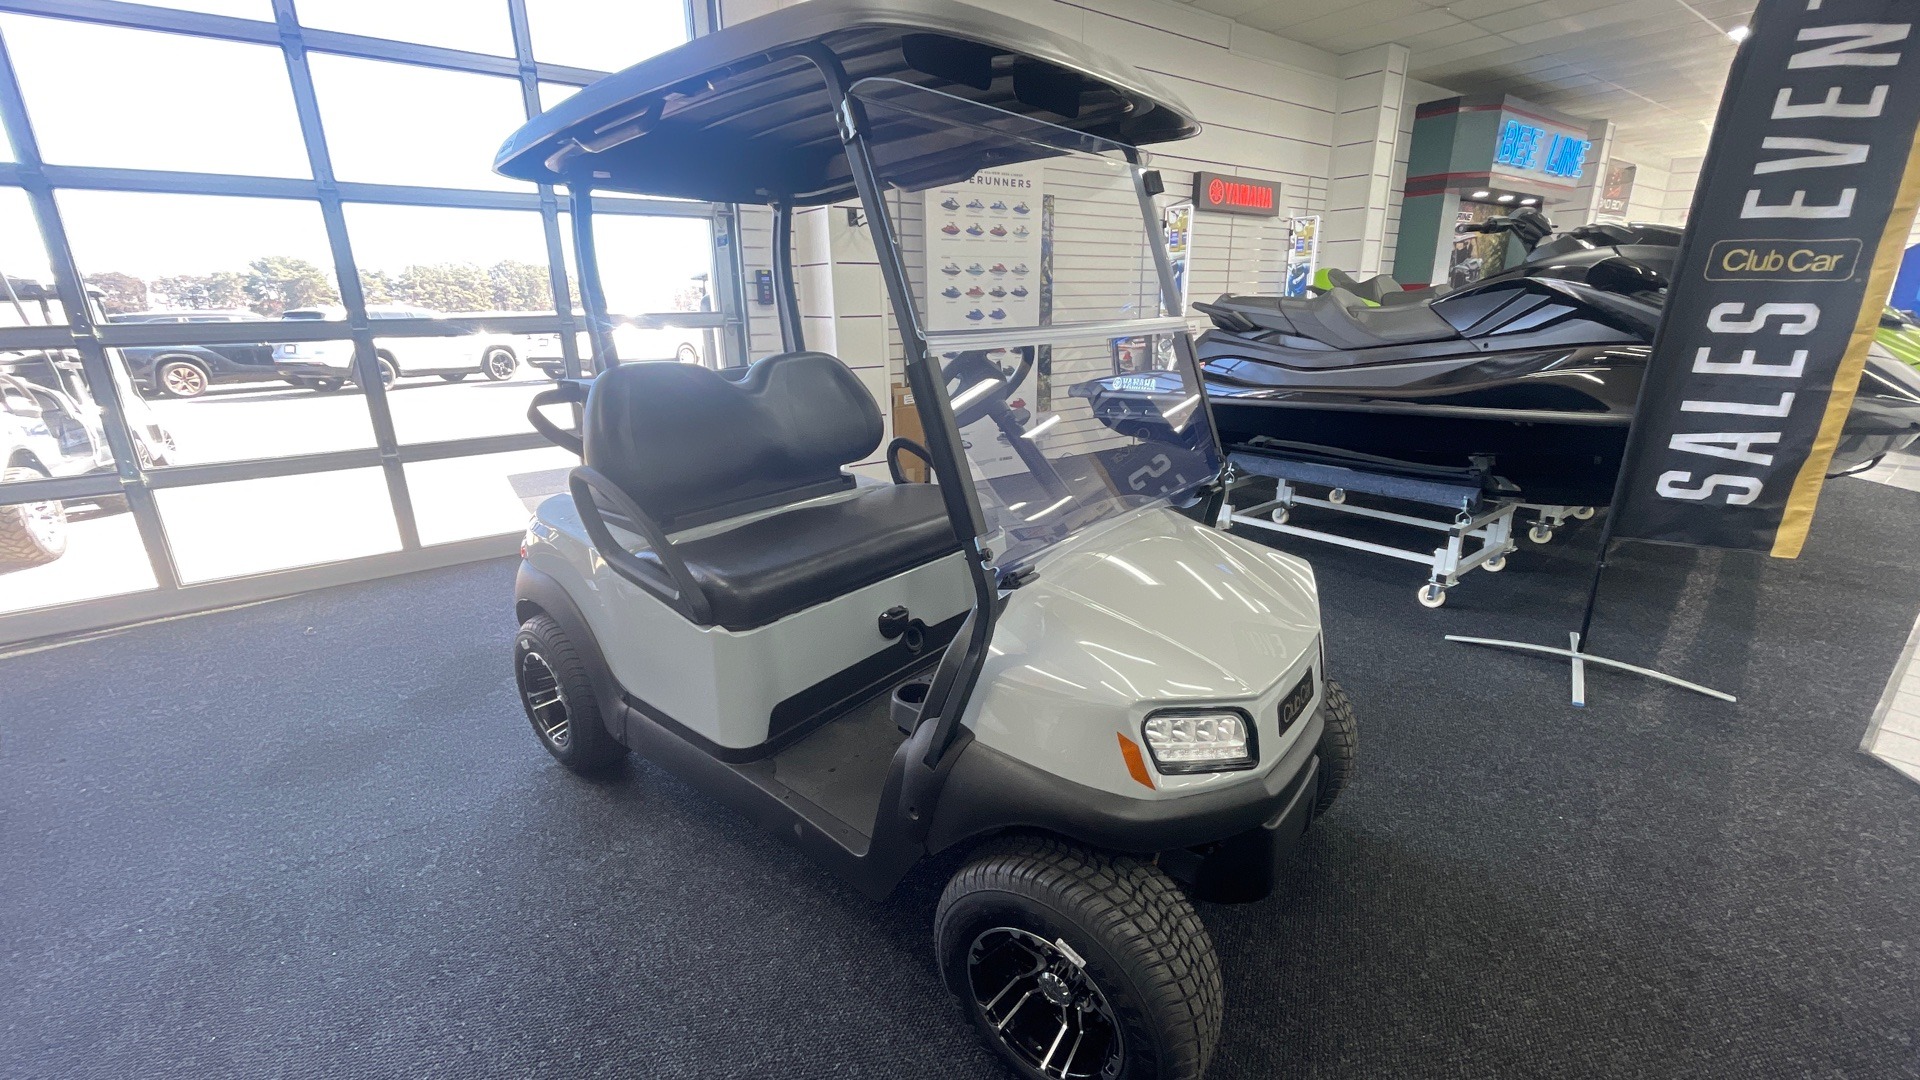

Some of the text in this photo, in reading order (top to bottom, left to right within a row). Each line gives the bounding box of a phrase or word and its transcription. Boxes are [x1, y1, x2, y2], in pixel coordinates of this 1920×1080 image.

[1497, 120, 1592, 178] BEE LINE
[969, 175, 1032, 189] ERUNNERS
[1225, 182, 1273, 209] YAMAHA
[1656, 0, 1912, 506] SALES EVEN
[1722, 248, 1844, 273] Club Car
[1122, 377, 1157, 390] YAMAHA
